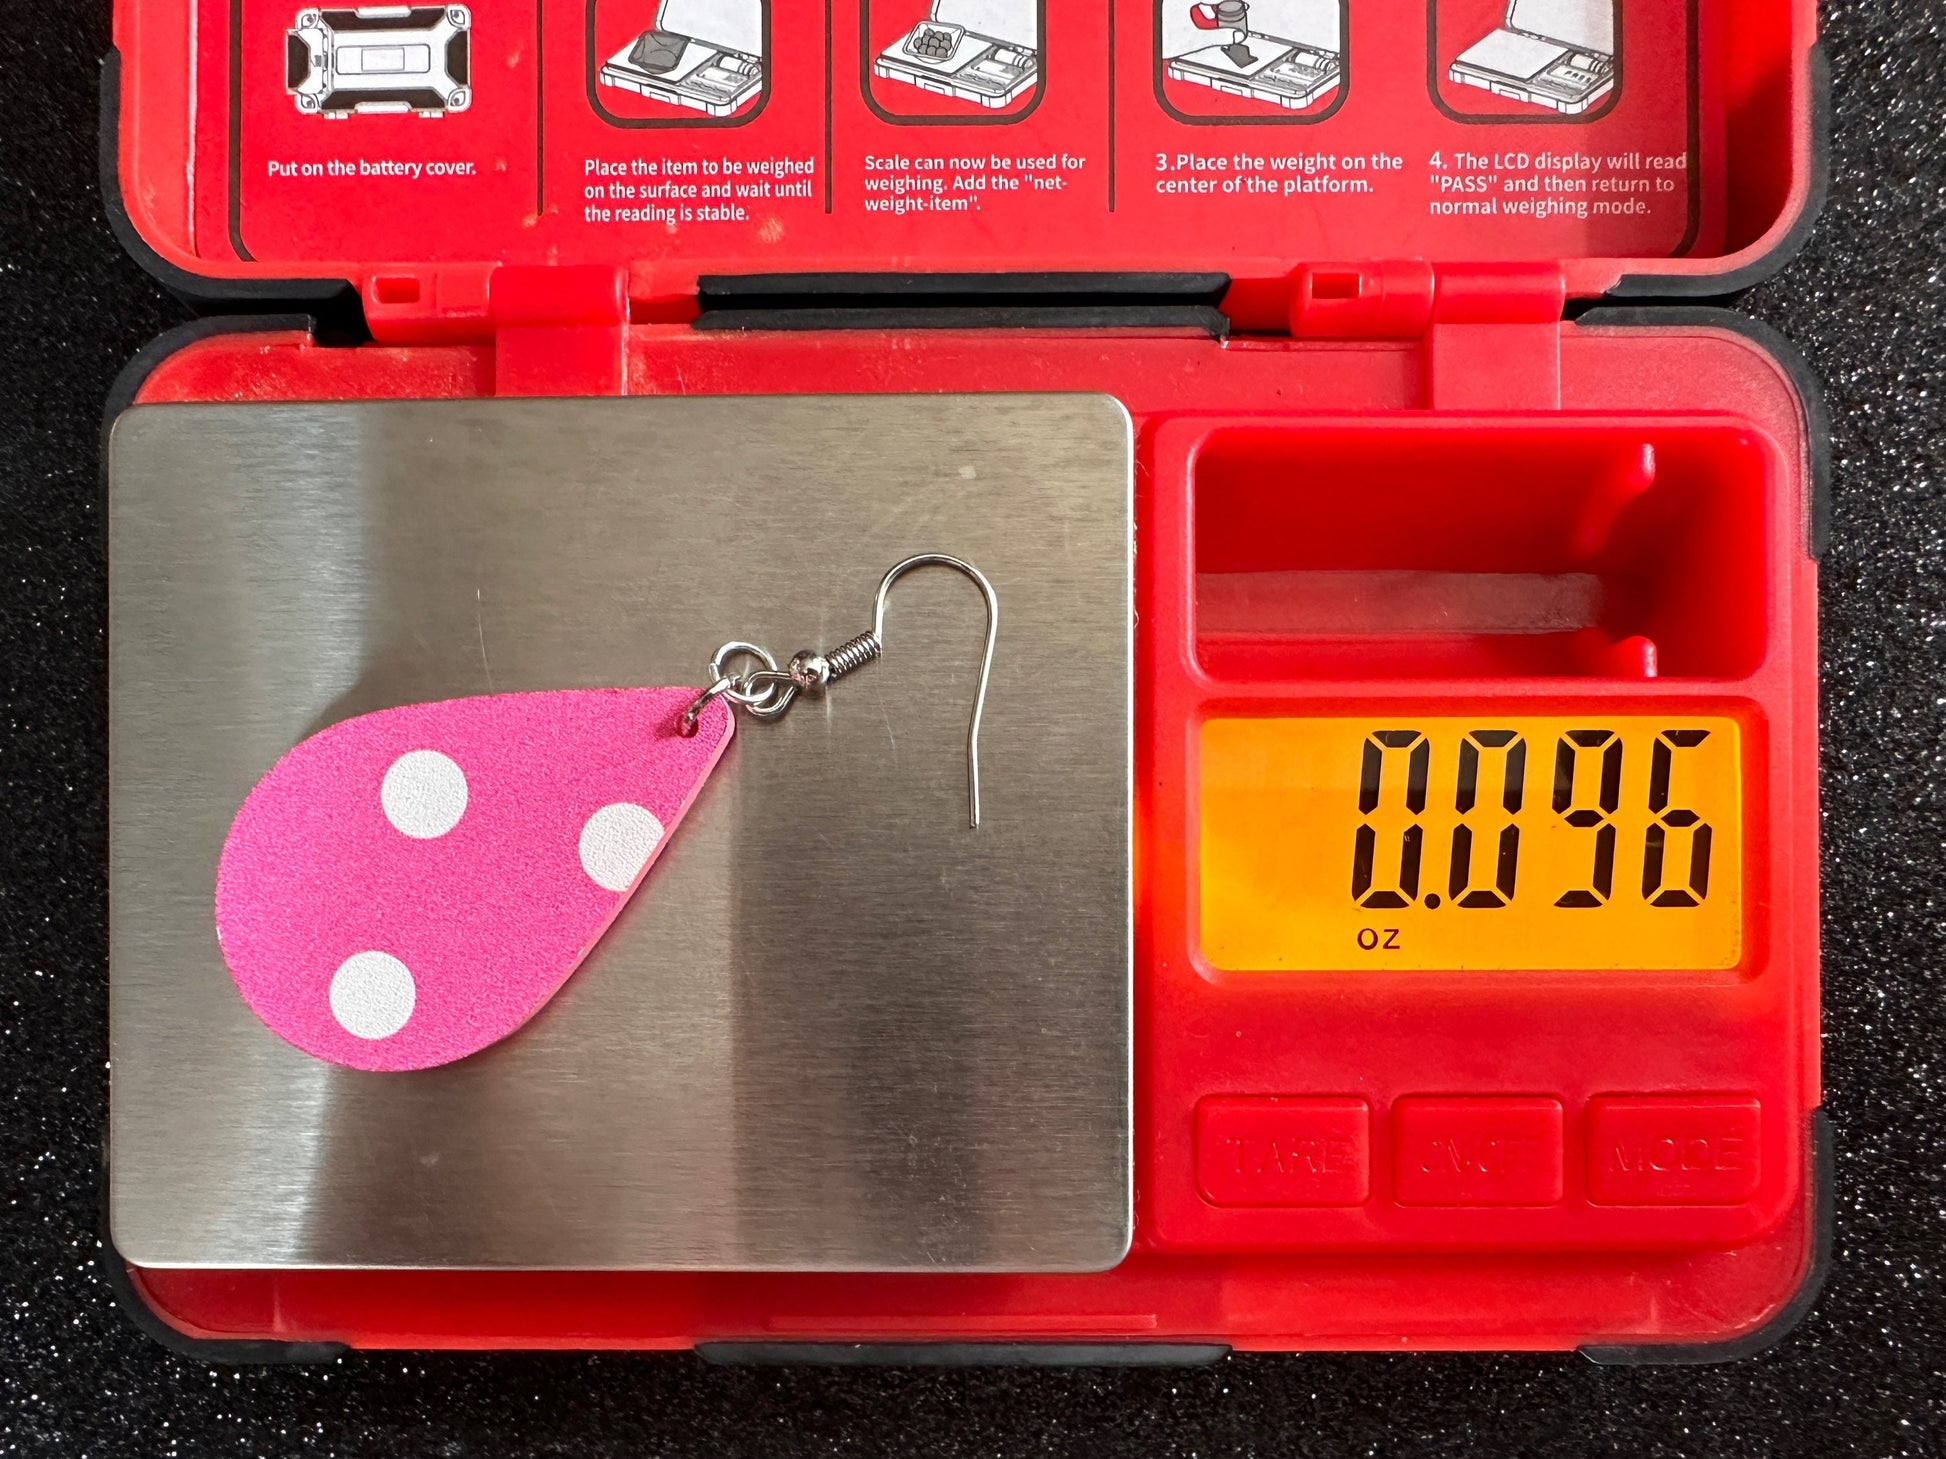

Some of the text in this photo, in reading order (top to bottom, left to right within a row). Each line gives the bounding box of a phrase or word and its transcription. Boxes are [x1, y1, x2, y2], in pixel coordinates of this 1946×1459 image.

[267, 157, 477, 180] Put on the battery cover.
[584, 156, 815, 179] Place the item to be weighed
[864, 152, 1087, 171] Scale can now be used for
[1232, 152, 1265, 171] the
[1269, 151, 1337, 175] weight
[1341, 156, 1366, 170] on
[1370, 151, 1404, 170] the
[1428, 150, 1688, 174] 4. The LCD display will read
[583, 179, 813, 200] on the surface and wait until
[864, 173, 1068, 195] weighing. Add the "net-
[1155, 174, 1374, 198] center of the platform.
[1429, 174, 1675, 193] "PASS" and then return to
[583, 202, 750, 226] the reading is stable.
[864, 194, 981, 216] weight-item".
[1429, 196, 1651, 220] normal weighing mode.
[1352, 730, 1713, 908] 0.096
